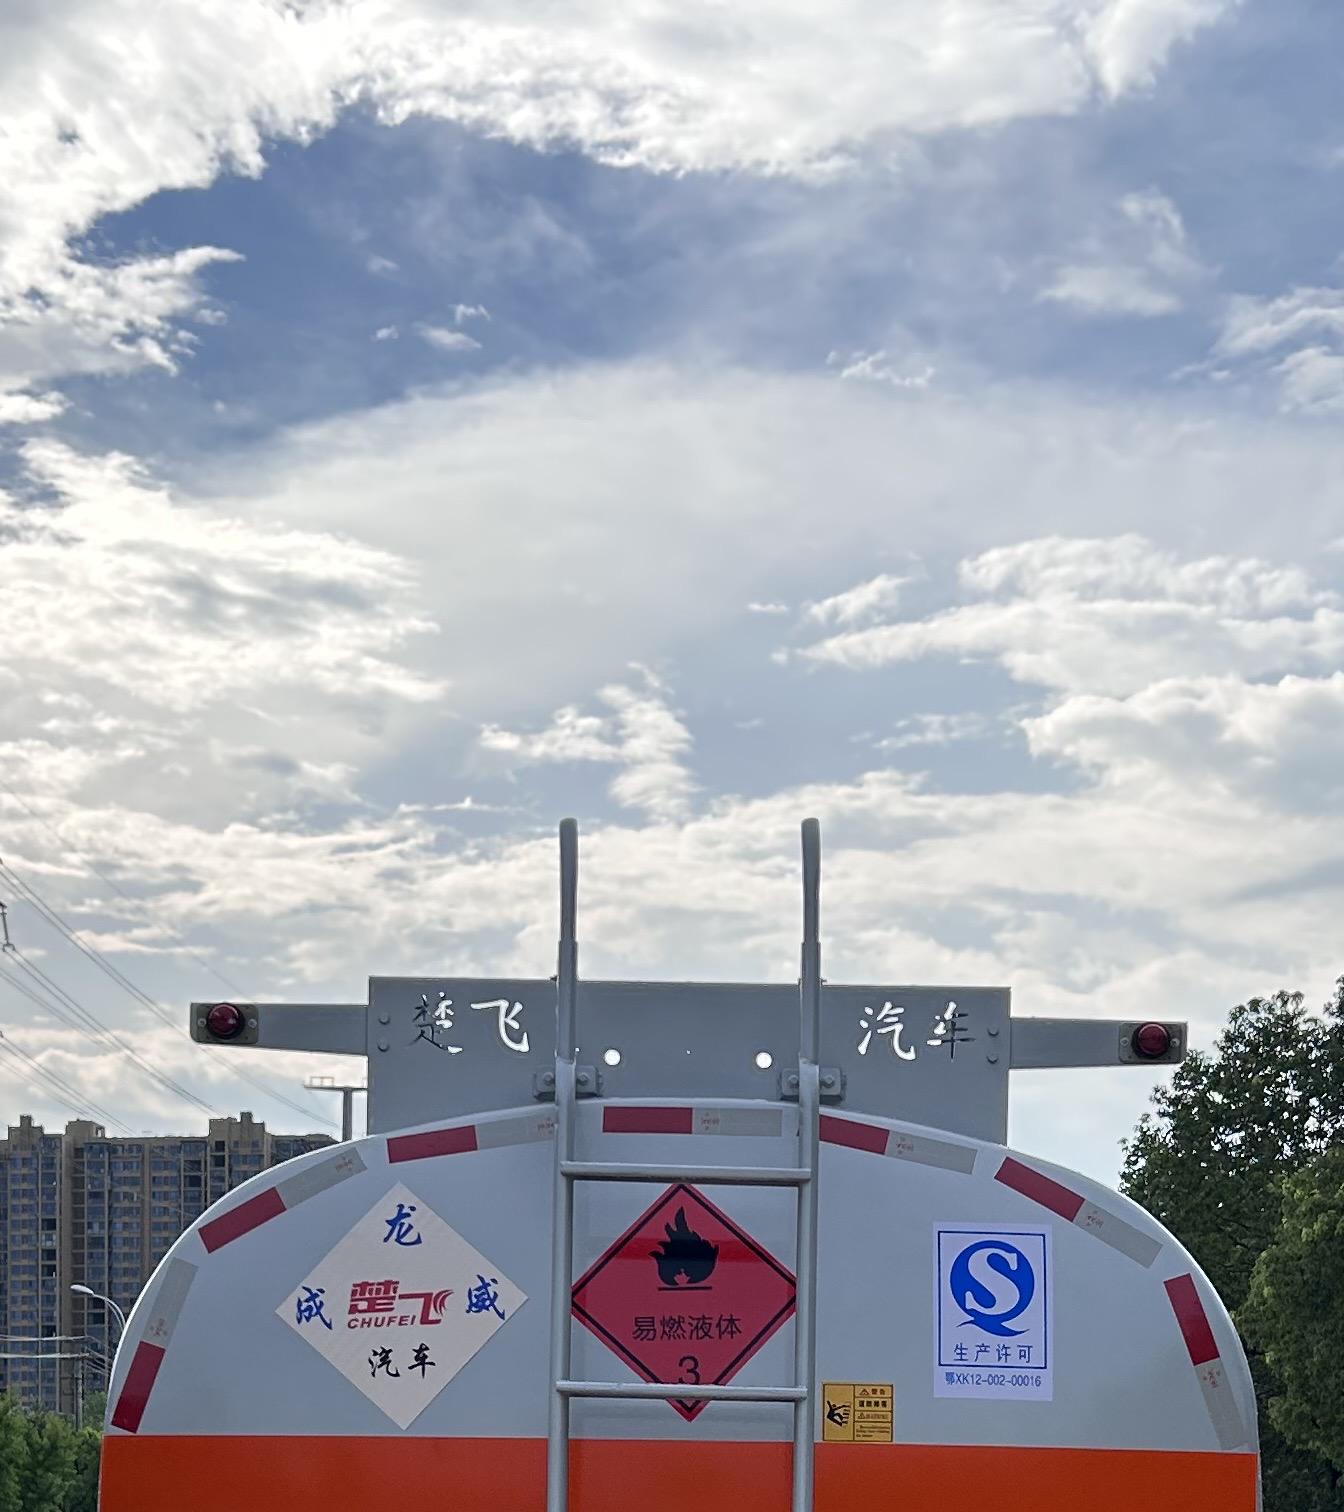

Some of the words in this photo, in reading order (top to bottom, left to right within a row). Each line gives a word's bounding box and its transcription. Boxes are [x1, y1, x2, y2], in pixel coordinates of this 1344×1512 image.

[857, 1001, 976, 1062] 汽车
[383, 1203, 422, 1247] 龙
[296, 1285, 333, 1331] 成
[465, 1274, 506, 1321] 威
[347, 1314, 417, 1330] CHUFEI
[632, 1313, 743, 1342] 易燃液体
[367, 1342, 437, 1380] 汽车
[677, 1355, 702, 1385] 3
[953, 1342, 1034, 1364] 生产许可
